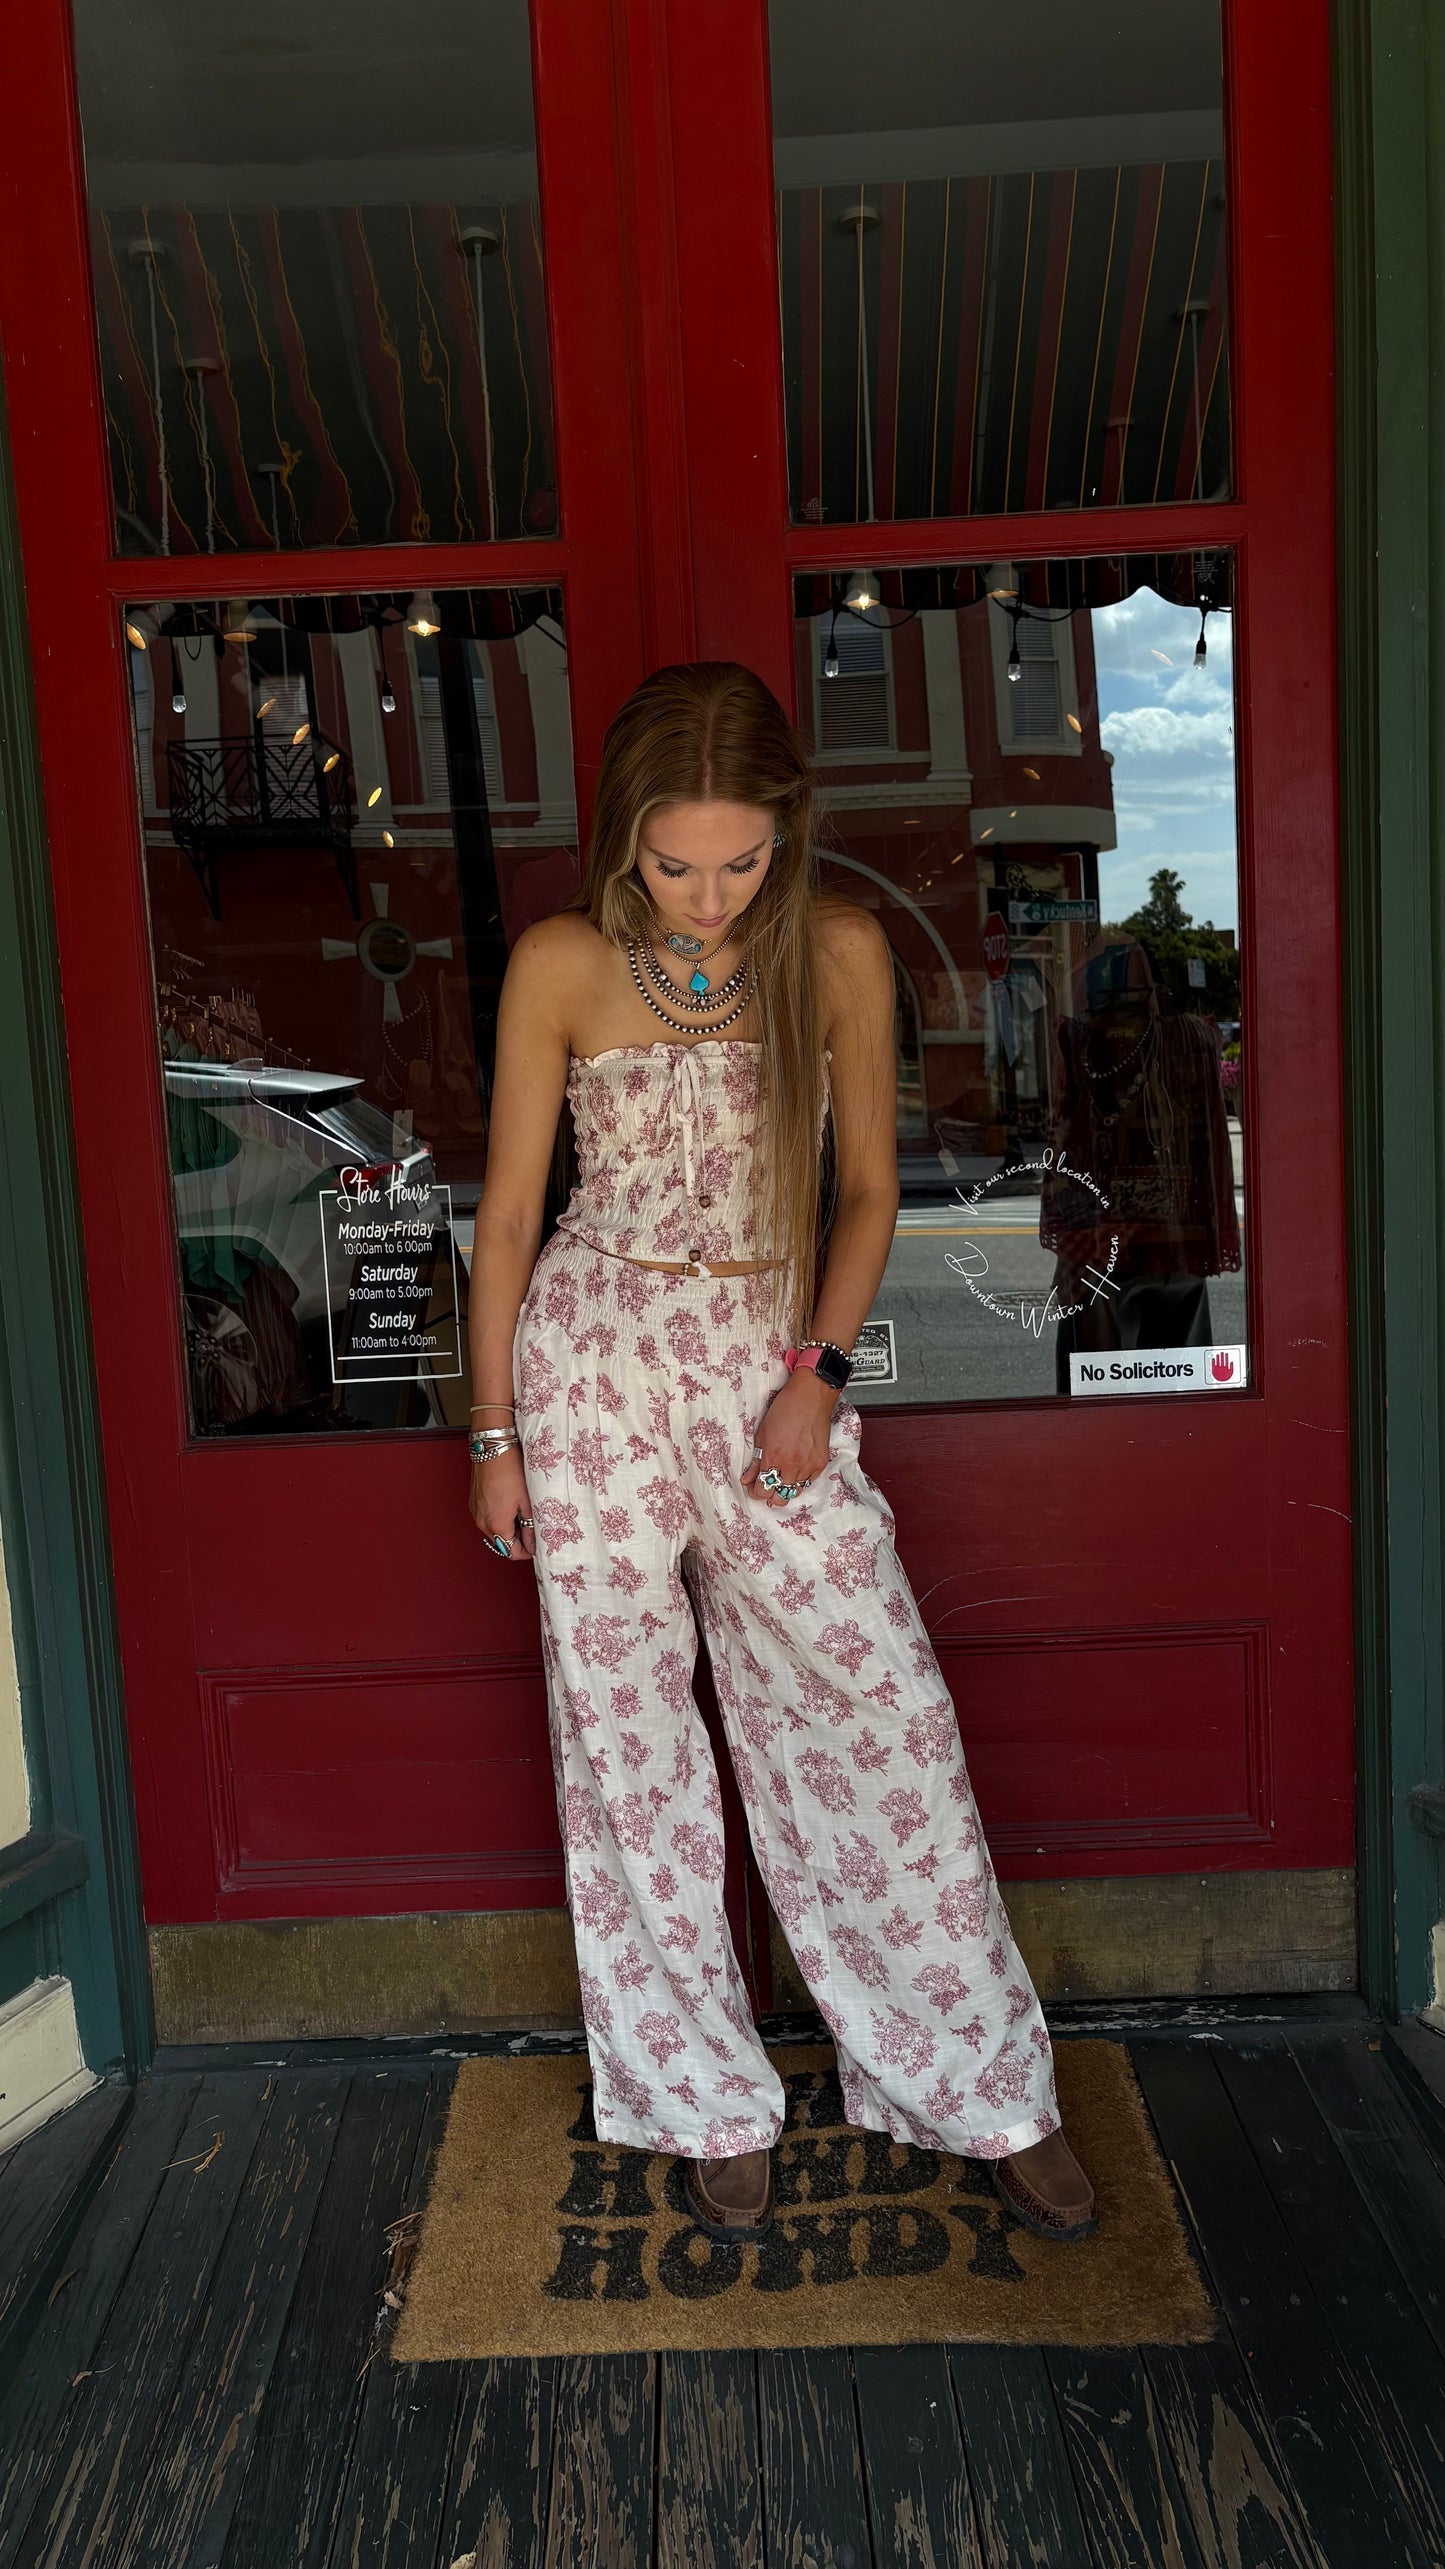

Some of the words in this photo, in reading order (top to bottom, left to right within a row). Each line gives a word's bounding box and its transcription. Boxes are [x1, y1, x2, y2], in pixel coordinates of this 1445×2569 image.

[336, 1166, 381, 1213] Store
[384, 1164, 432, 1212] Hours
[948, 1181, 985, 1216] Visit
[985, 1171, 1005, 1187] our
[1005, 1147, 1053, 1177] second
[1056, 1151, 1101, 1197] location
[1099, 1194, 1110, 1209] in
[338, 1219, 435, 1241] Monday-Friday
[343, 1242, 383, 1256] 10:00am
[385, 1242, 395, 1254] to
[360, 1263, 418, 1283] Saturday
[348, 1288, 384, 1300] 9:00am
[386, 1287, 396, 1299] to
[944, 1241, 1016, 1320] Downtown
[1020, 1285, 1084, 1338] Winter
[1080, 1234, 1121, 1306] Haven
[369, 1311, 417, 1330] Sunday
[351, 1336, 388, 1349] 11:00am
[389, 1335, 399, 1348] to
[1080, 1363, 1105, 1382] No
[1109, 1360, 1194, 1380] Solicitors
[542, 2203, 1030, 2301] HOWDY
